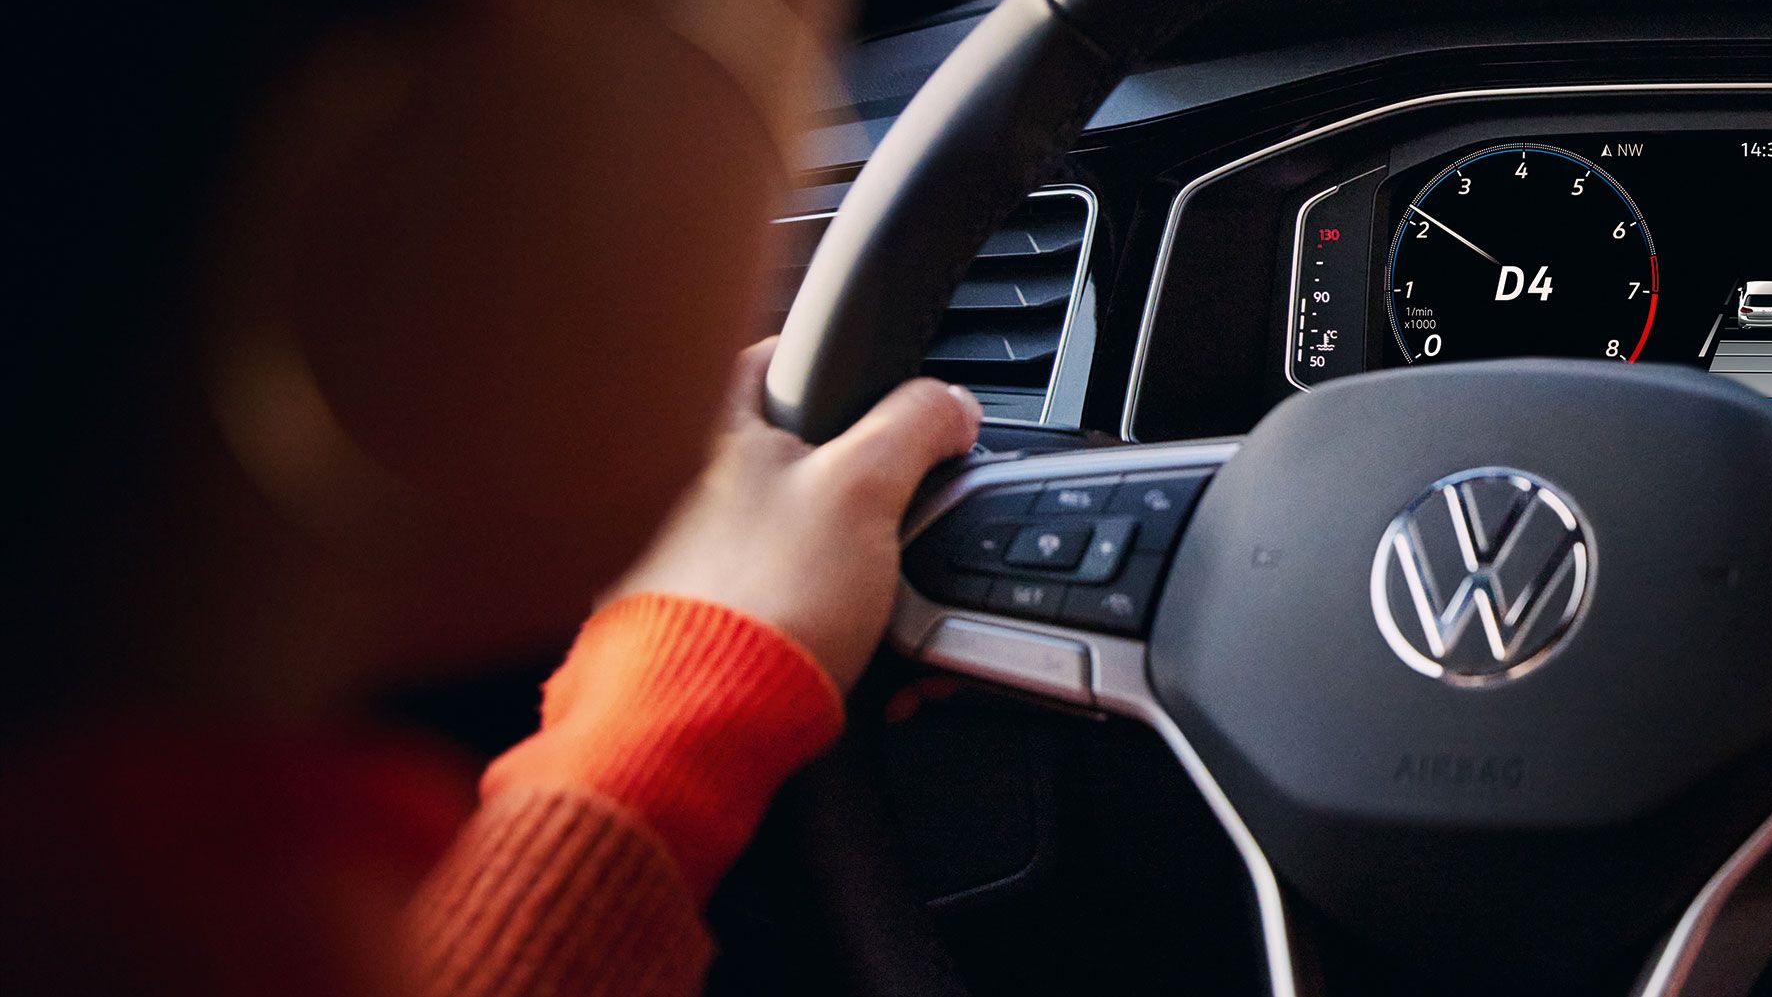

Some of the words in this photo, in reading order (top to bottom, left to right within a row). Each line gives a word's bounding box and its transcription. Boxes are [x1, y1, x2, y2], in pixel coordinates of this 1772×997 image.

[1618, 144, 1643, 156] NW
[1515, 162, 1528, 178] 4
[1458, 178, 1472, 194] 3
[1571, 178, 1585, 195] 5
[1320, 229, 1340, 240] 130
[1416, 221, 1430, 239] 2
[1613, 222, 1625, 239] 6
[1406, 281, 1413, 298] 1
[1495, 266, 1553, 301] D4
[1628, 282, 1640, 299] 7
[1314, 292, 1330, 303] 90
[1406, 307, 1433, 317] 1/min
[1405, 320, 1436, 329] x1000
[1424, 333, 1442, 357] 0
[1605, 339, 1619, 357] 8
[1310, 356, 1325, 367] 50
